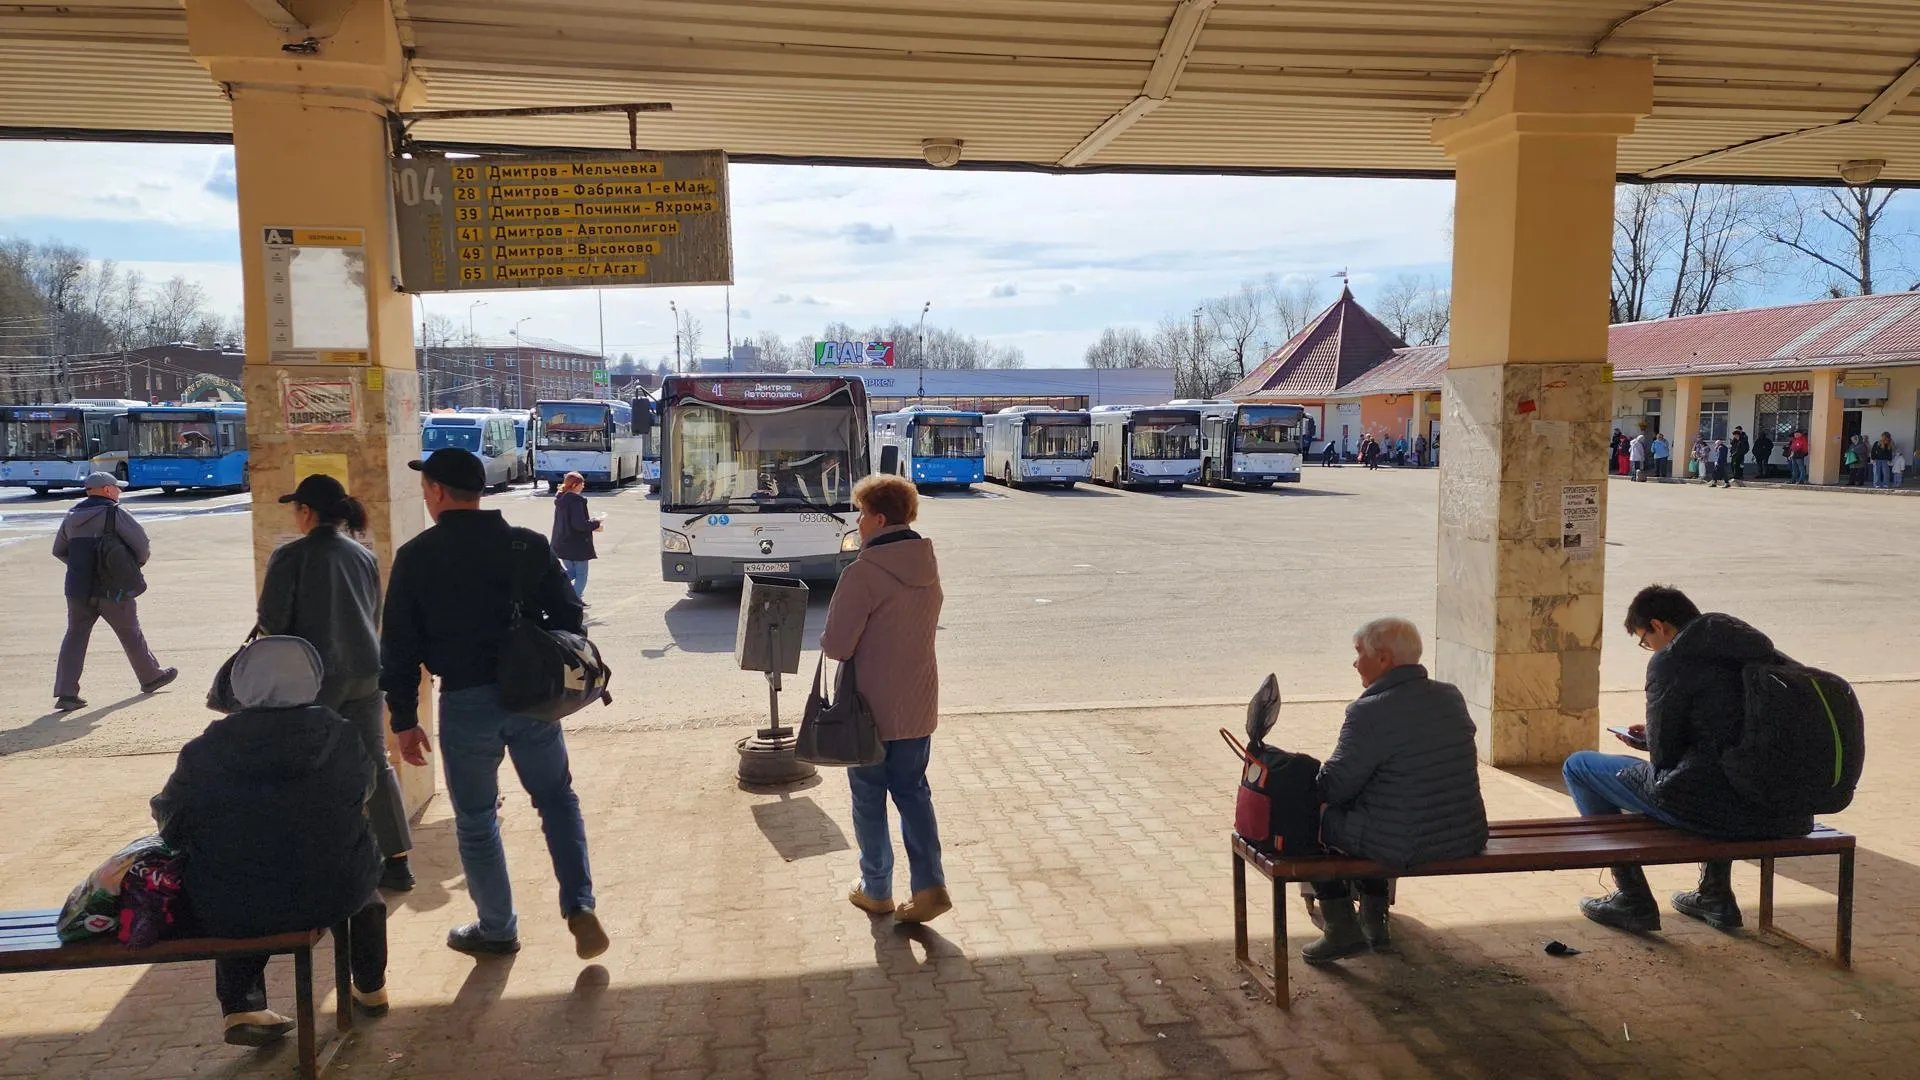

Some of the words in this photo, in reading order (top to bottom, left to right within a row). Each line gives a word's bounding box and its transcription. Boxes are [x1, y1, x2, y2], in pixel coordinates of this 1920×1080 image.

[456, 169, 474, 180] 20
[489, 167, 557, 181] Дмитров
[572, 163, 657, 176] Мельчевка
[402, 168, 443, 207] 04
[458, 188, 475, 200] 28
[491, 186, 558, 201] Дмитров
[574, 183, 642, 196] Фабрика
[460, 209, 477, 220] 39
[492, 206, 559, 221] Дмитров
[575, 204, 640, 215] Починки
[655, 201, 712, 214] Яхрома
[462, 230, 478, 241] 41
[495, 226, 562, 241] Дмитров
[578, 222, 676, 235] Автополигон
[462, 249, 480, 259] 49
[496, 245, 562, 260] Дмитров
[578, 242, 653, 255] Высоково
[464, 268, 481, 279] 65
[496, 266, 562, 280] Дмитров
[579, 264, 599, 276] с/т
[604, 262, 637, 273] Агат
[822, 341, 864, 364] ДА!
[712, 383, 723, 397] 41
[744, 390, 802, 398] Автополигон
[755, 383, 792, 391] Дмитров
[1763, 380, 1809, 392] ОДЕЖДА
[800, 513, 833, 522] 093060
